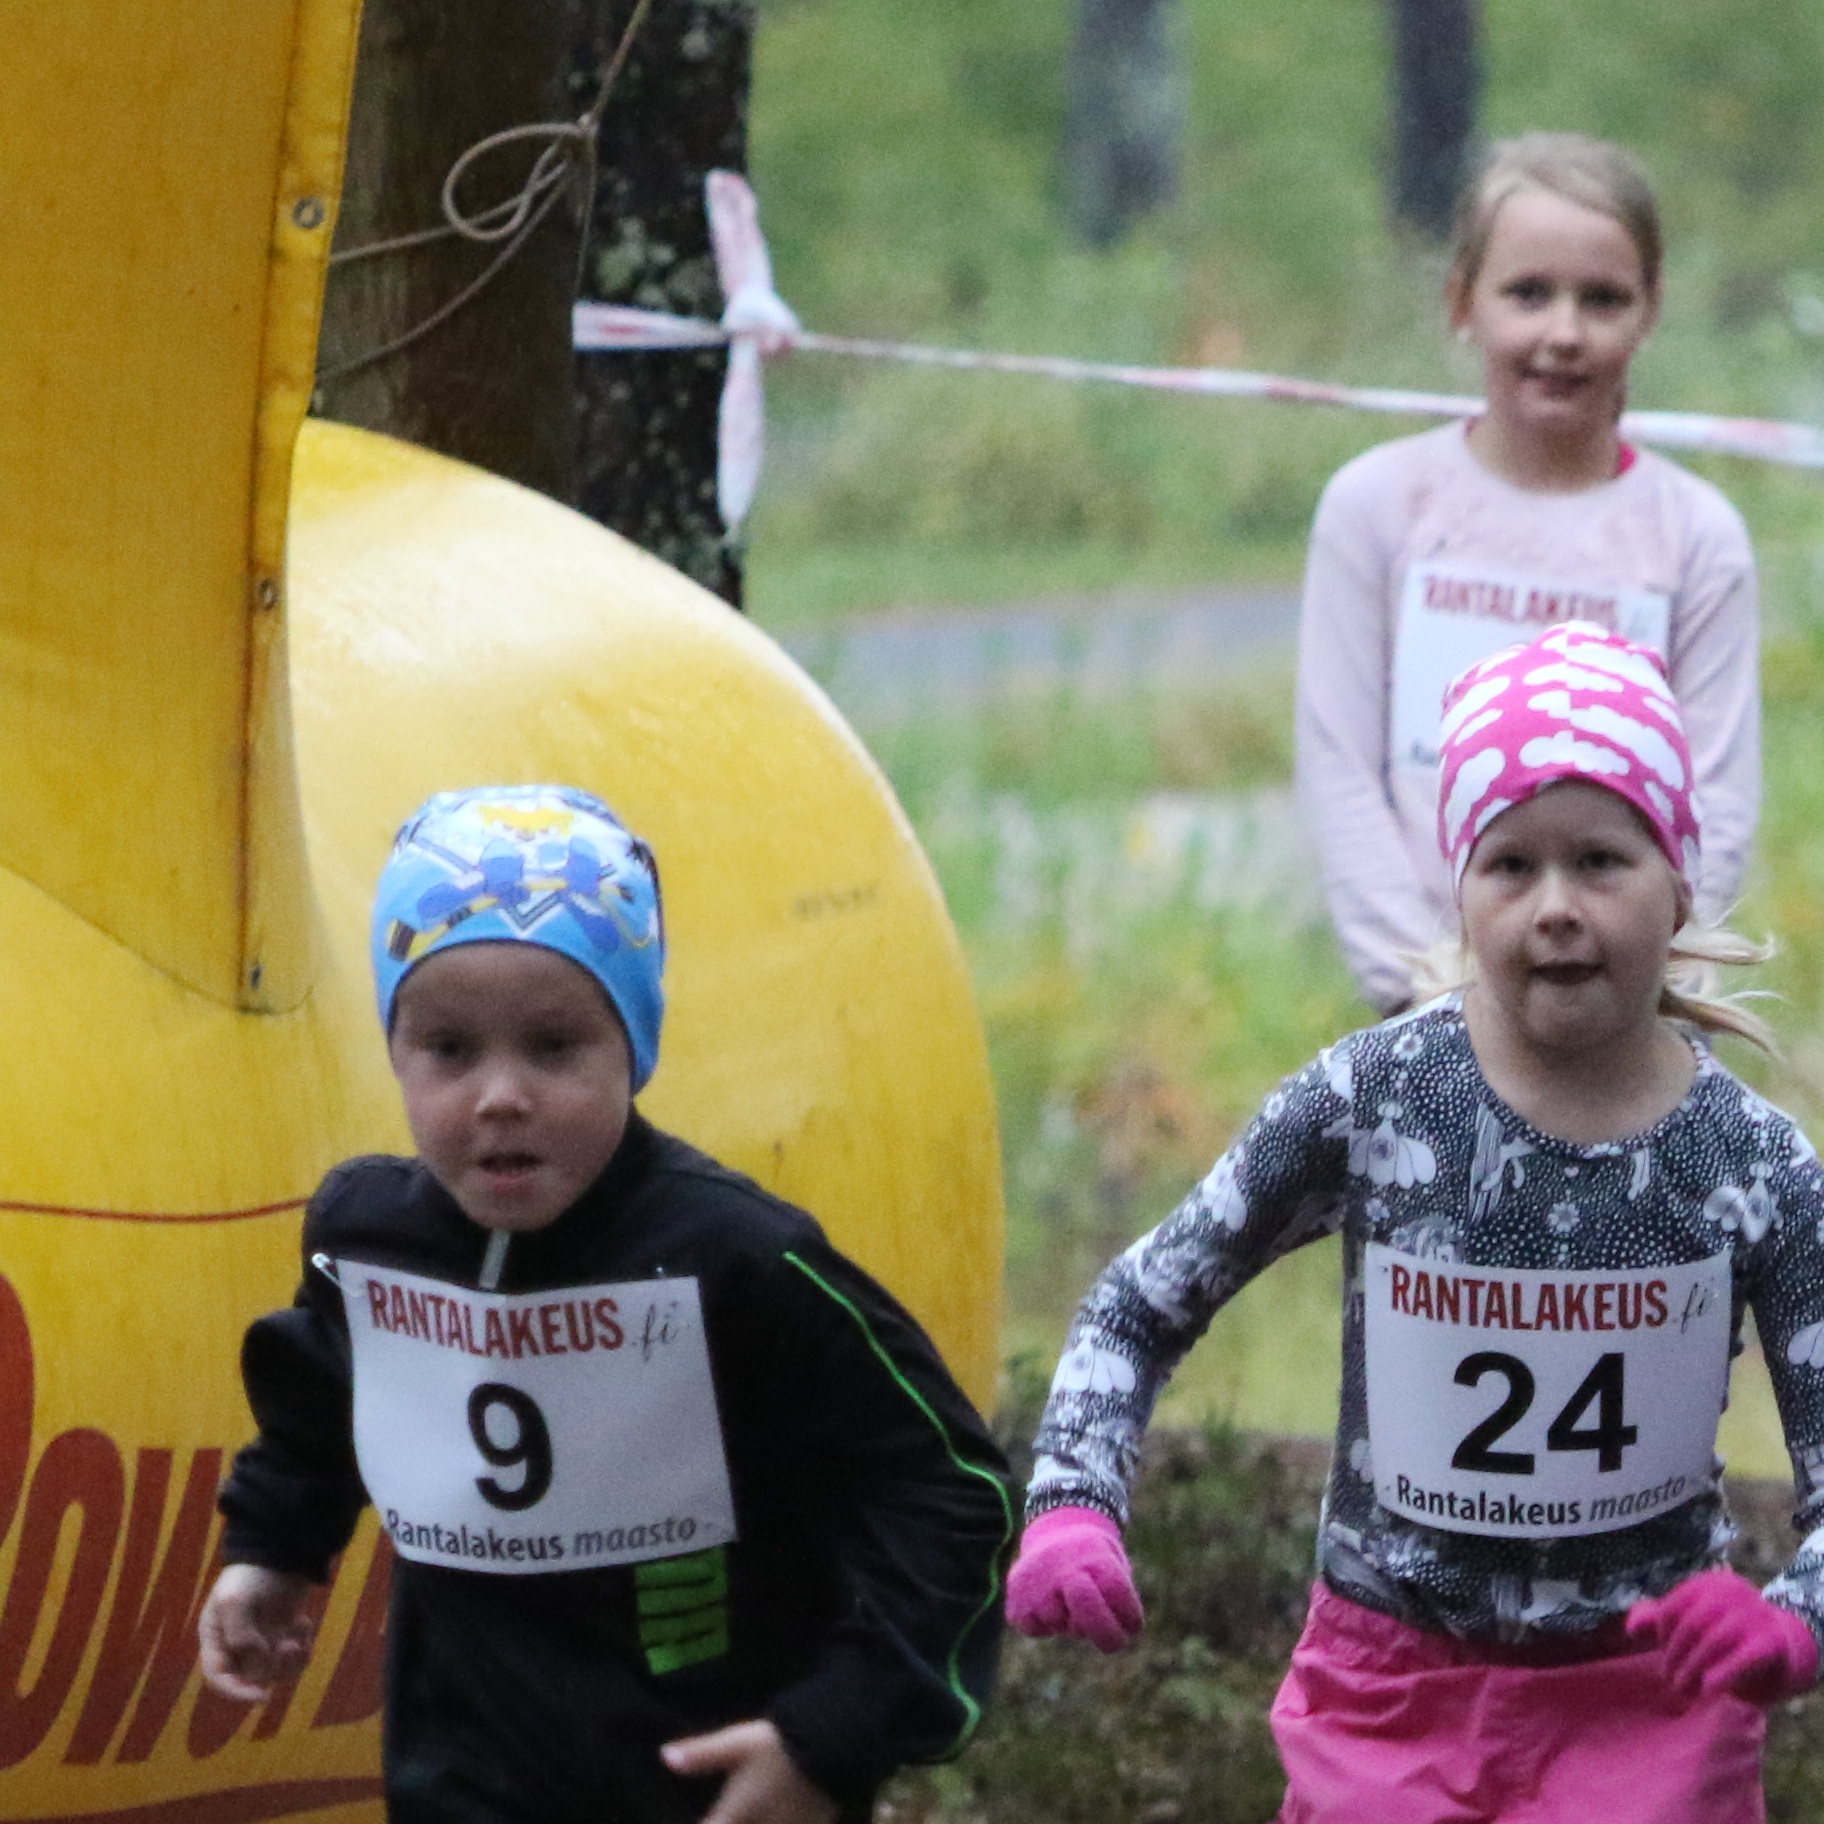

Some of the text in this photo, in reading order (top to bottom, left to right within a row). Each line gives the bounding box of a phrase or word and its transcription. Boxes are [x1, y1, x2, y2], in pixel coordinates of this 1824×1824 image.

[467, 1381, 554, 1512] 9
[1450, 1350, 1638, 1475] 24
[386, 1508, 697, 1561] Rantalakeus maasto
[1397, 1474, 1686, 1525] Rantalakeus maasto
